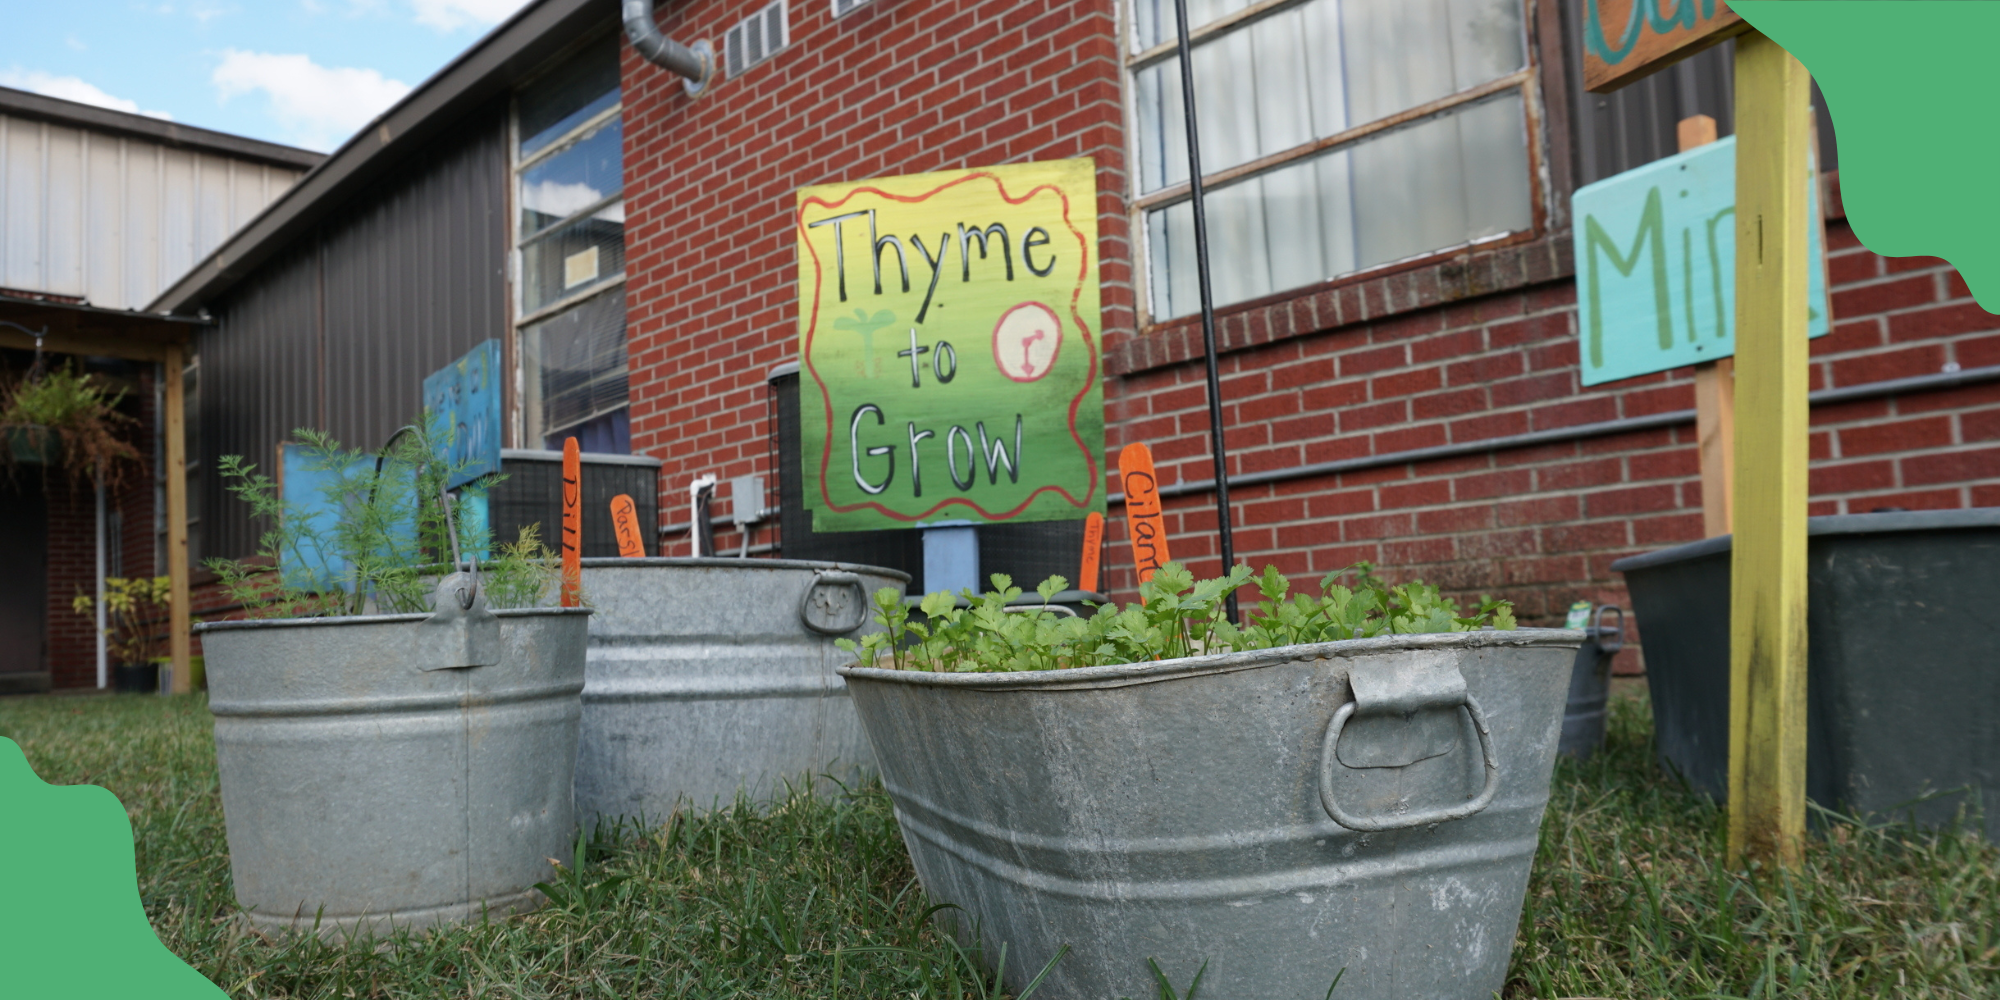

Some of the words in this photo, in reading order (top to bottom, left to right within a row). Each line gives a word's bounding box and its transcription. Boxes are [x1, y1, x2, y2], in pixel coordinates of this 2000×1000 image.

[808, 208, 1056, 324] Thyme
[1585, 178, 1814, 369] Min
[897, 327, 957, 388] to
[850, 403, 1022, 498] Grow
[562, 474, 578, 552] Dill
